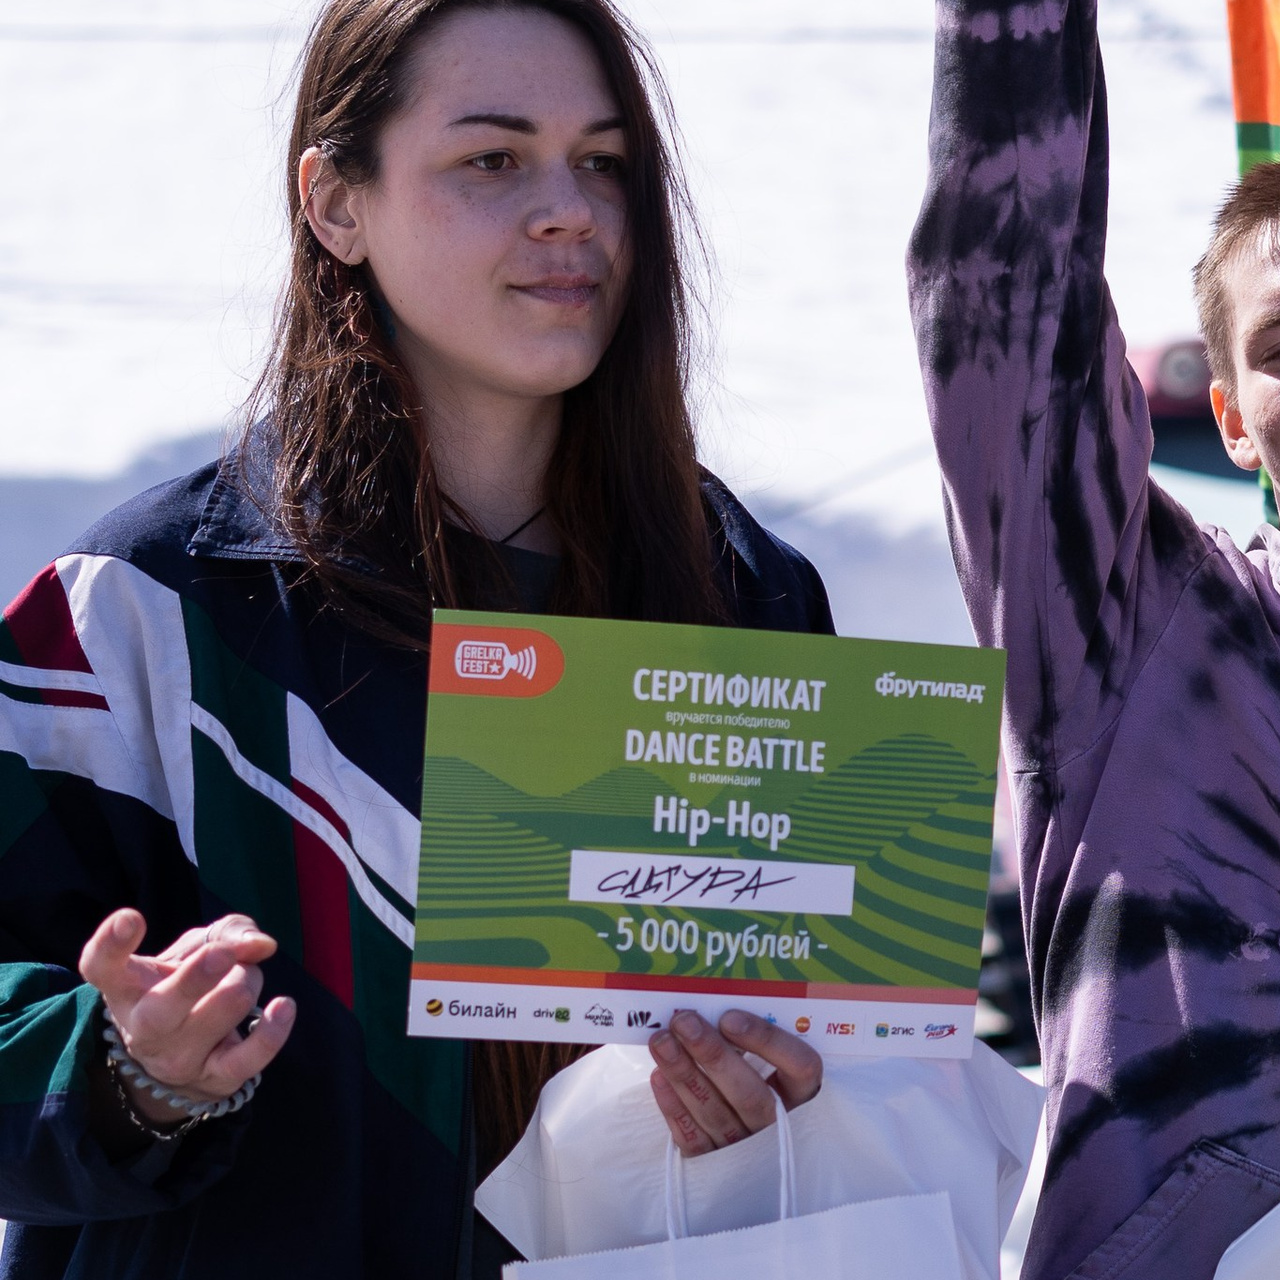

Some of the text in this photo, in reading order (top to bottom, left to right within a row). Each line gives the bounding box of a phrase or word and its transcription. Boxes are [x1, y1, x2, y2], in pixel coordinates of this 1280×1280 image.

[463, 646, 503, 660] GRELKA
[462, 660, 489, 673] FEST
[633, 668, 826, 712] СЕРТИФИКАТ
[875, 671, 986, 704] фрутилад
[666, 711, 790, 729] вручается победителю
[625, 728, 826, 773] DANCE BATTLE
[689, 772, 761, 787] в номинации
[653, 795, 791, 852] Hip-Hop
[706, 923, 811, 967] рублей
[449, 1000, 517, 1019] билайн
[533, 1006, 571, 1022] drivee
[891, 1026, 915, 1036] 2ГИС
